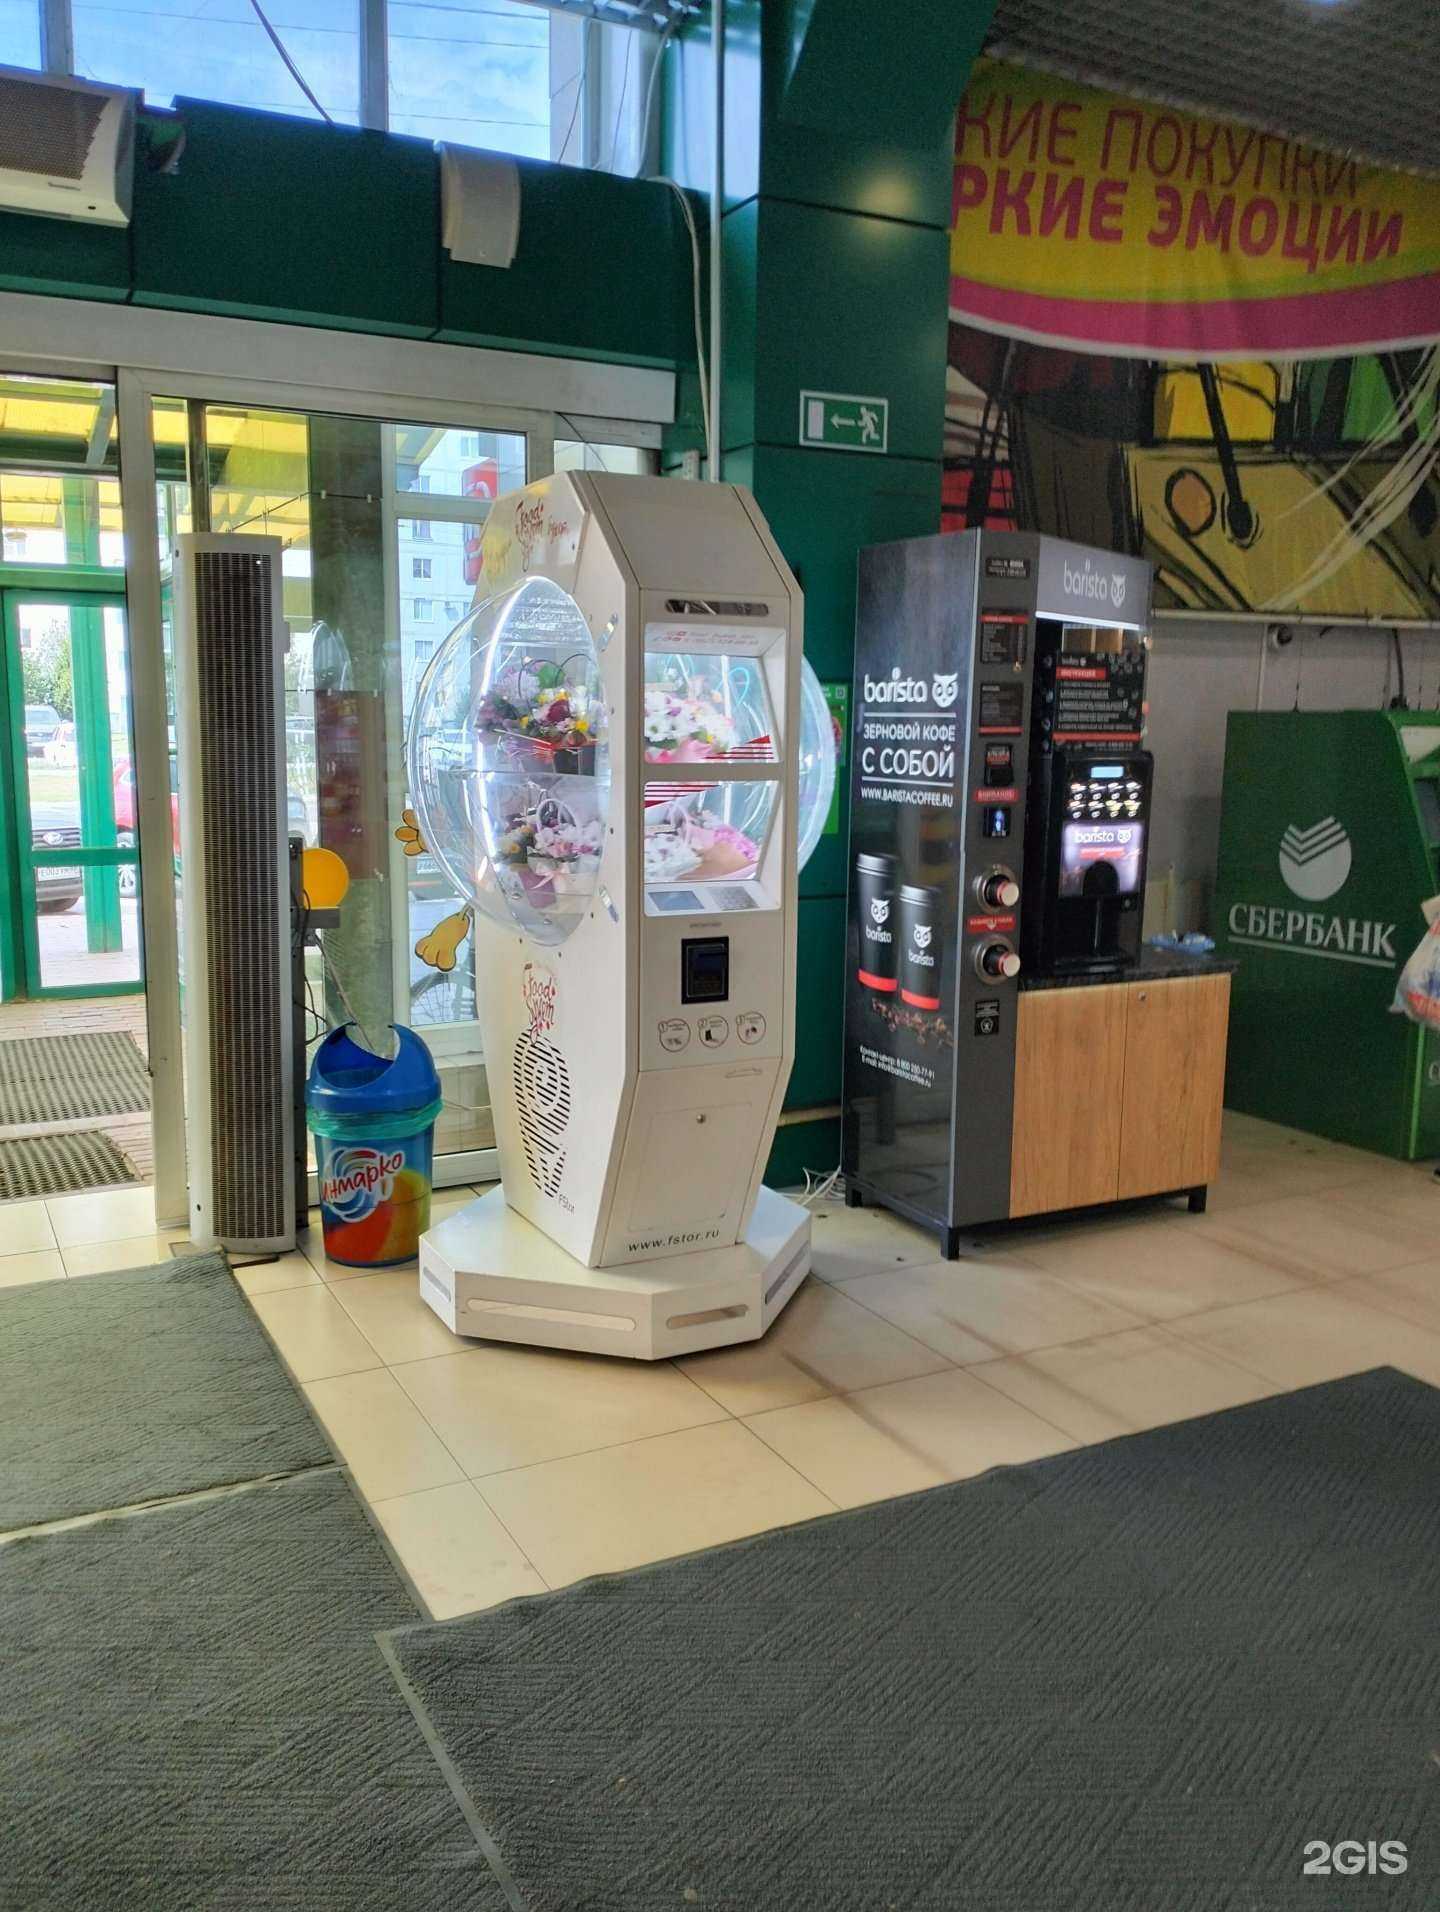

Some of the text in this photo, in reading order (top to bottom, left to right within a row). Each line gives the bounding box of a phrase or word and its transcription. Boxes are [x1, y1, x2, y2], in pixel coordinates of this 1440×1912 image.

[1101, 108, 1358, 199] ПОКУПКИ
[951, 164, 1404, 274] РКИЕ ЭМОЦИИ
[1063, 559, 1108, 601] barista
[863, 667, 928, 703] barista
[863, 720, 956, 742] ЗЕРНОВОЙ КОФЕ
[861, 746, 876, 774] С
[879, 743, 955, 779] СОБОЙ
[1072, 825, 1115, 844] barista
[865, 925, 892, 944] barista
[1228, 901, 1398, 959] СБЕРБАНК
[907, 950, 935, 968] barista
[627, 1229, 720, 1253] www.fstor.ru
